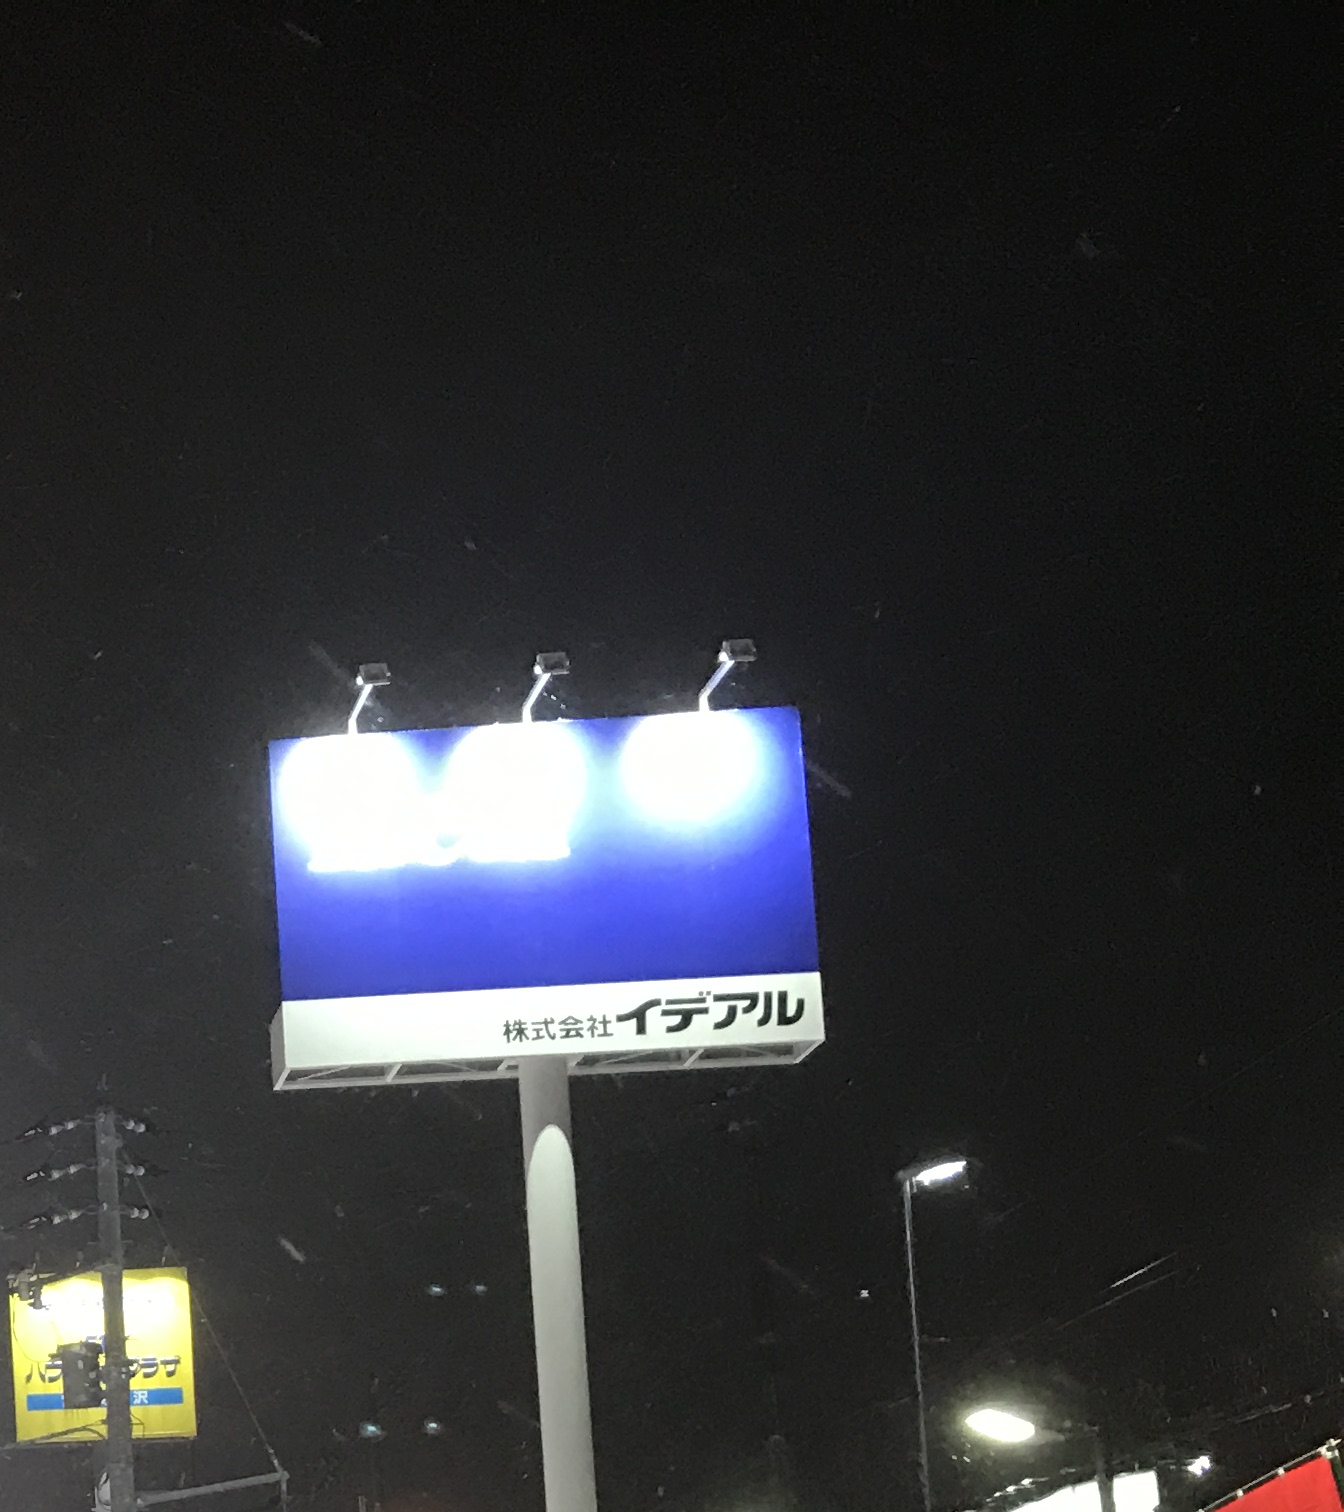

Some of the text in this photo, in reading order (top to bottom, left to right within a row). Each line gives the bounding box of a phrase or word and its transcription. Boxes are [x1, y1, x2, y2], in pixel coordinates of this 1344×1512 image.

[502, 989, 806, 1043] 株式会社イデアル
